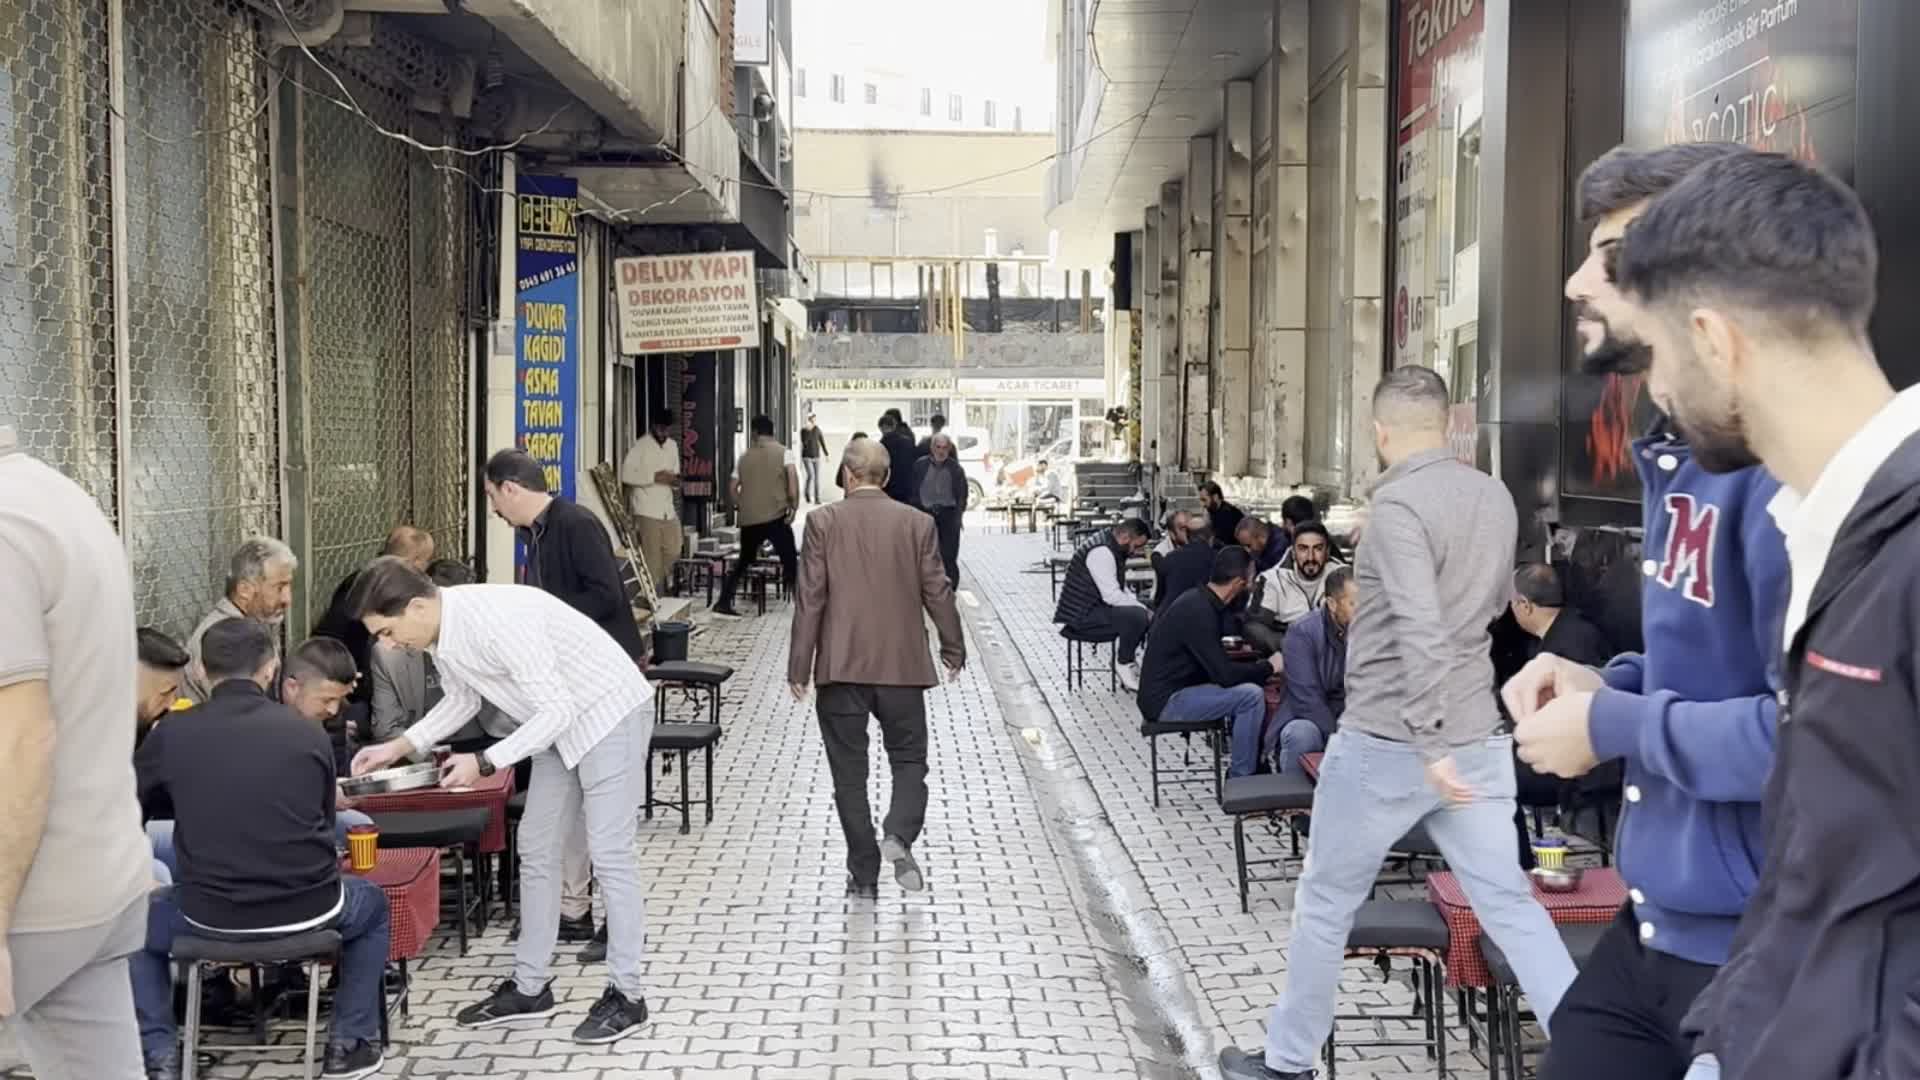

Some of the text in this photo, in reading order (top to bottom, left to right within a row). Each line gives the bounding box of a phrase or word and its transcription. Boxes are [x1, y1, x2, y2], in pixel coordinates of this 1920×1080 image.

[519, 193, 577, 237] DELUX
[622, 255, 748, 285] DELUX YAPI
[628, 285, 746, 306] DEKORASYON
[723, 303, 750, 311] TAVAN
[525, 302, 567, 333] DUVAR
[525, 368, 560, 397] ASMA
[523, 400, 563, 429] TAVAN
[525, 433, 564, 462] SARAY
[1656, 492, 1720, 608] M
